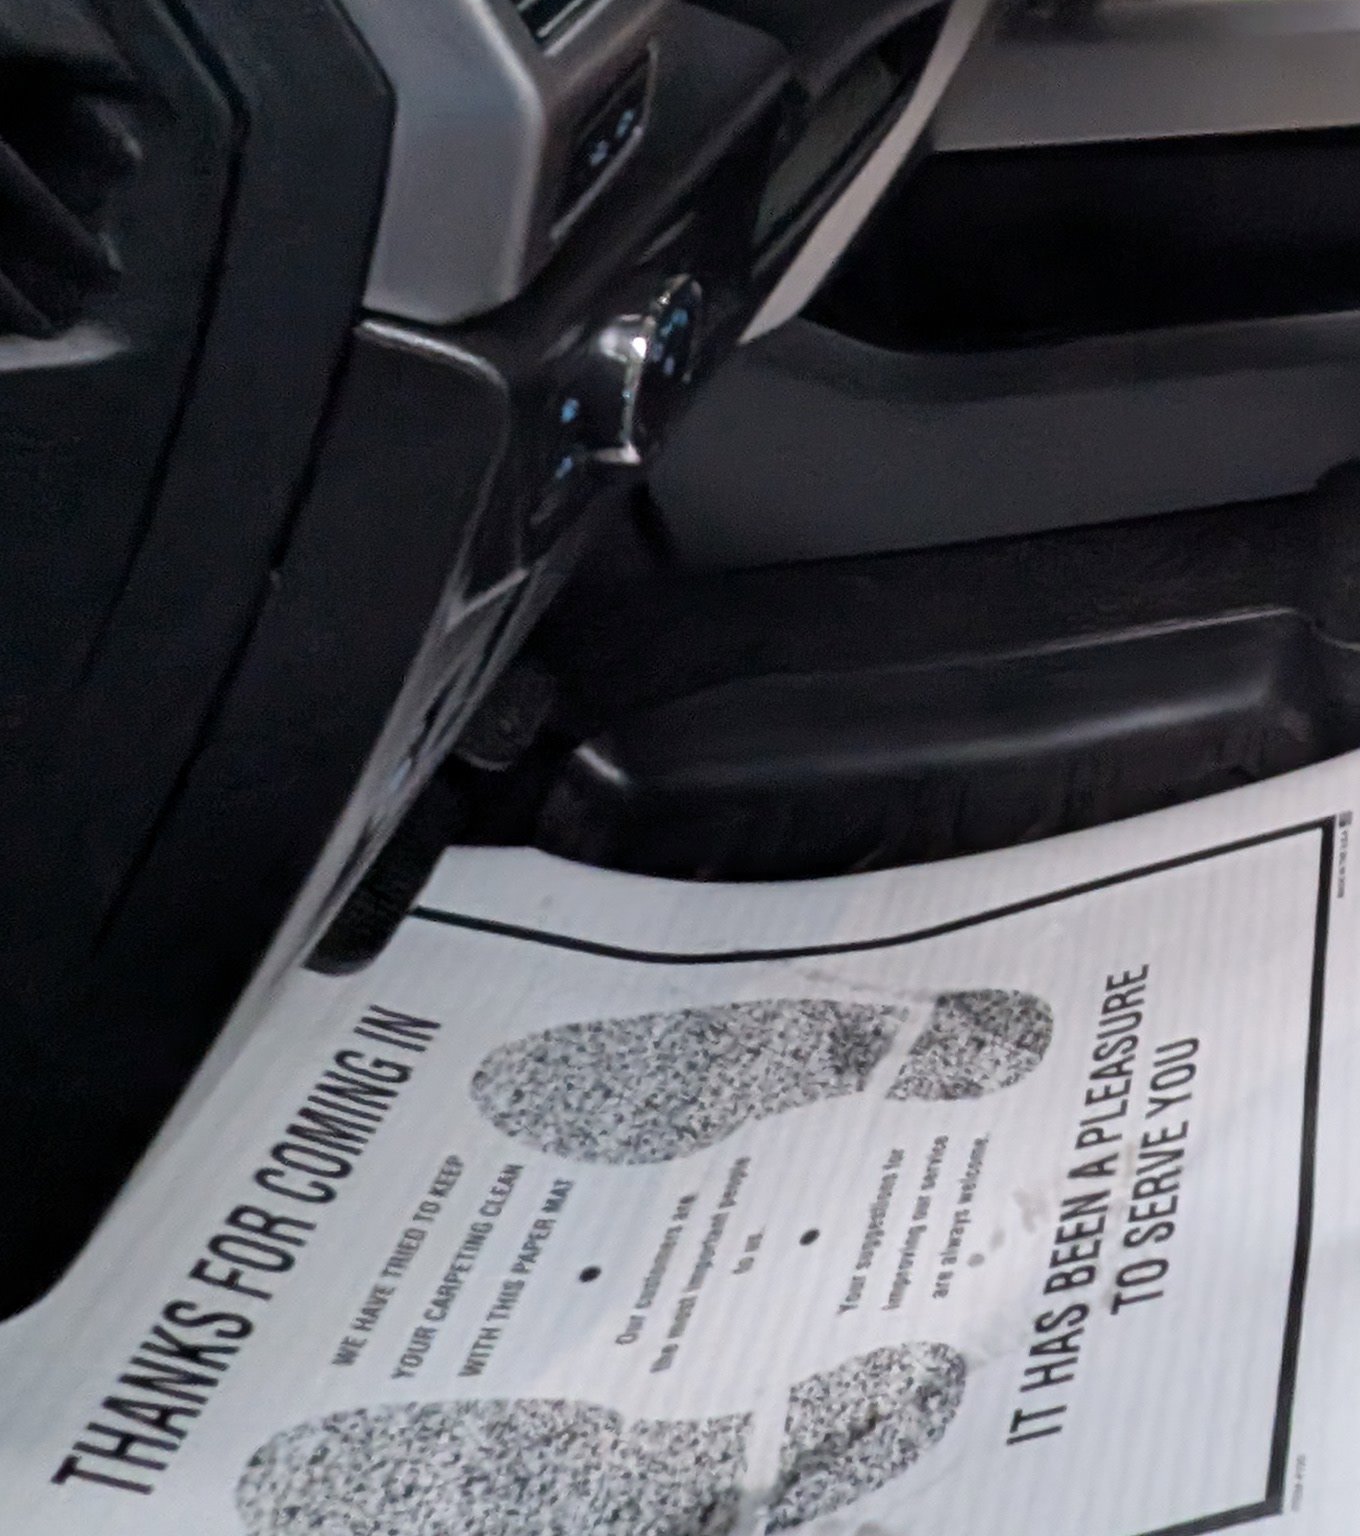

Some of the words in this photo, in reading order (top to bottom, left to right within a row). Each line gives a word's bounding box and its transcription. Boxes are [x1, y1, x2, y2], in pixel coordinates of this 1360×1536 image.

[1075, 964, 1149, 1151] PLEASURE
[1146, 1037, 1200, 1120] YOU
[718, 1157, 751, 1210] people
[921, 1135, 949, 1190] service
[1068, 1156, 1121, 1180] A
[1124, 1119, 1188, 1246] SERVE
[837, 1275, 867, 1315] Your
[855, 1173, 898, 1271] suggestions
[882, 1149, 905, 1171] for
[912, 1195, 931, 1221] our
[939, 1209, 972, 1266] always
[1043, 1189, 1111, 1296] BEEN
[50, 1299, 254, 1495] THANKS
[189, 1204, 317, 1301] FOR
[254, 1049, 413, 1204] COMING
[353, 1004, 441, 1053] IN
[331, 1335, 369, 1366] WE
[352, 1283, 396, 1332] HAVE
[380, 1228, 428, 1278] TRIED
[413, 1200, 442, 1223] TO
[429, 1154, 465, 1198] KEEP
[391, 1326, 438, 1380] YOUR
[423, 1221, 494, 1322] CARPETING
[479, 1164, 525, 1217] CLEAN
[457, 1327, 502, 1377] WITH
[486, 1279, 526, 1321] THIS
[510, 1218, 557, 1275] PAPER
[541, 1178, 576, 1214] MAT
[615, 1315, 646, 1345] Our
[634, 1225, 683, 1309] customers
[682, 1212, 730, 1293] important
[732, 1256, 755, 1275] to
[881, 1225, 928, 1311] improving
[932, 1270, 954, 1299] are
[1110, 1256, 1170, 1316] TO
[650, 1343, 679, 1373] the
[667, 1296, 698, 1339] most
[1019, 1303, 1090, 1393] HAS
[1006, 1405, 1068, 1446] IT
